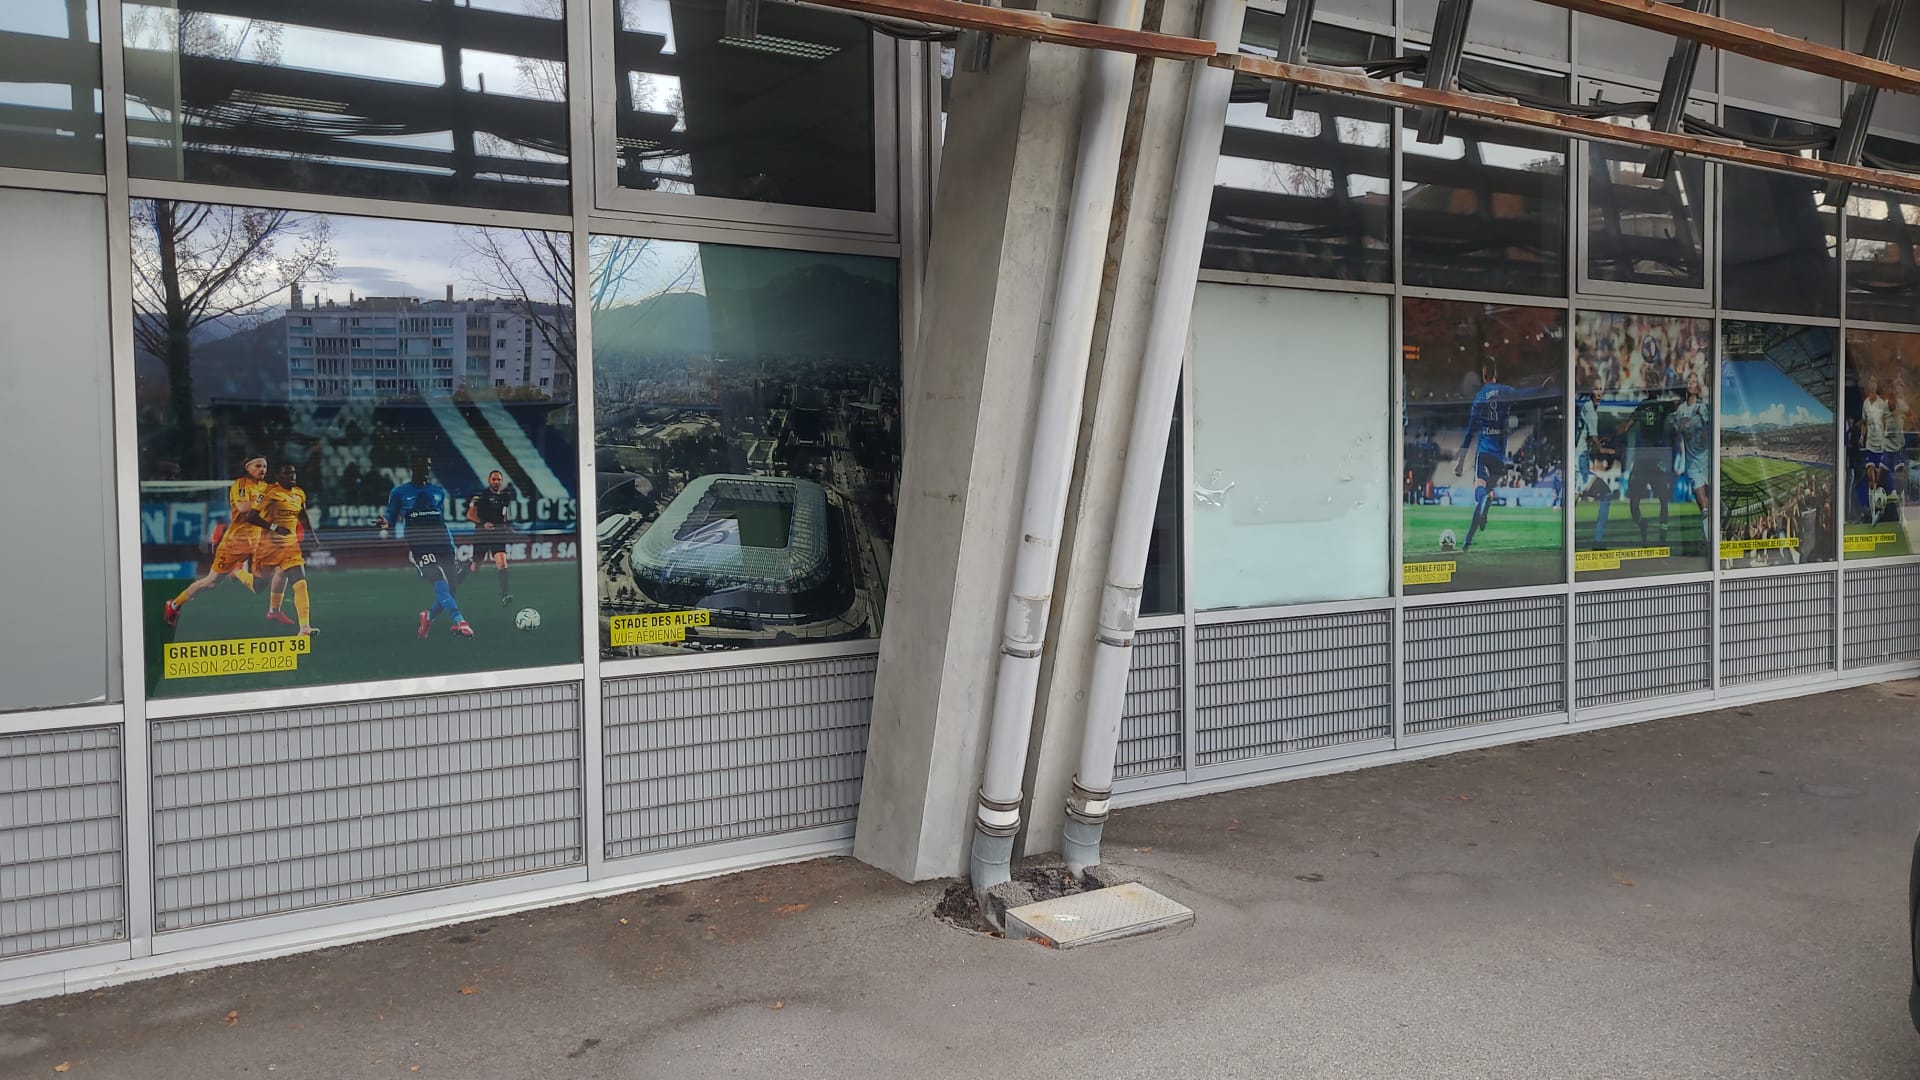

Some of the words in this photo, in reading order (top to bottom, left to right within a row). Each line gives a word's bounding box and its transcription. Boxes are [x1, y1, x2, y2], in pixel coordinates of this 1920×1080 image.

[1646, 411, 1655, 426] 12
[421, 553, 437, 565] 30
[531, 542, 553, 560] DE
[1404, 564, 1433, 574] GRENOBLE
[1433, 563, 1447, 572] FOOT
[614, 617, 648, 630] STADE
[651, 615, 672, 627] DES
[675, 613, 707, 625] ALPES
[614, 631, 633, 644] VUE
[636, 627, 683, 643] AÉRIENNE
[169, 643, 246, 659] GRENOBLE
[250, 640, 285, 654] FOOT
[289, 639, 306, 651] 38
[169, 660, 218, 676] SAISON
[222, 655, 293, 672] 2025-2026
